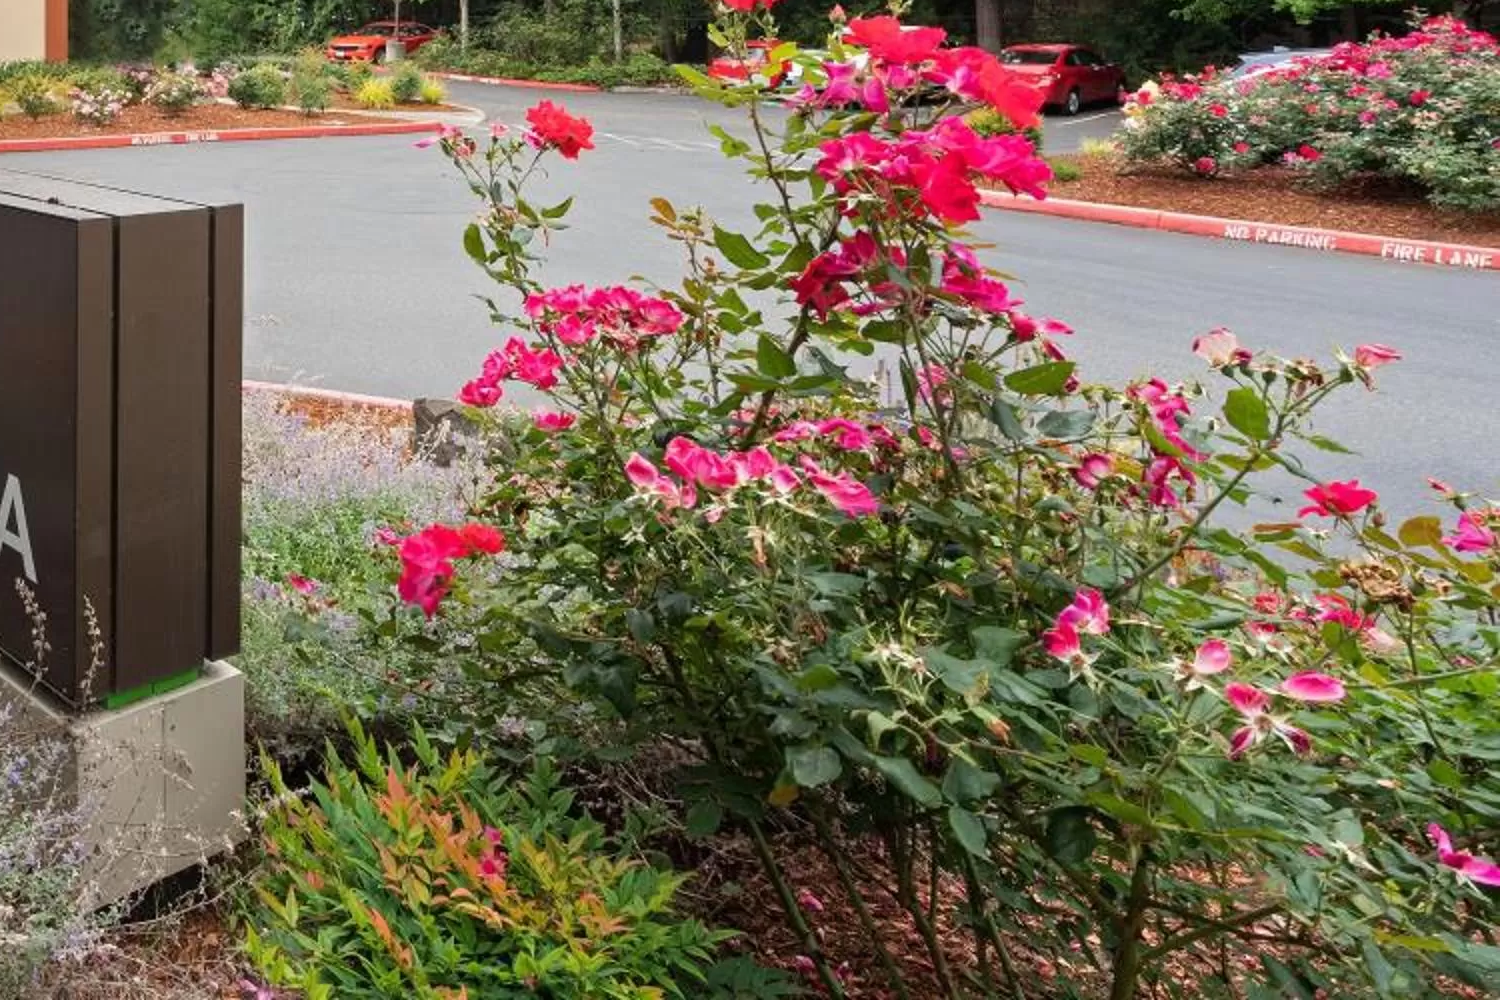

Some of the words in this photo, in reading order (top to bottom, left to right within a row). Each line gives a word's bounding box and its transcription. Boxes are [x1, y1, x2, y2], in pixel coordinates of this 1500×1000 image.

[1224, 224, 1249, 240] NO
[1255, 226, 1337, 250] PARKING
[1381, 242, 1425, 260] FIRE
[1434, 249, 1493, 268] LANE
